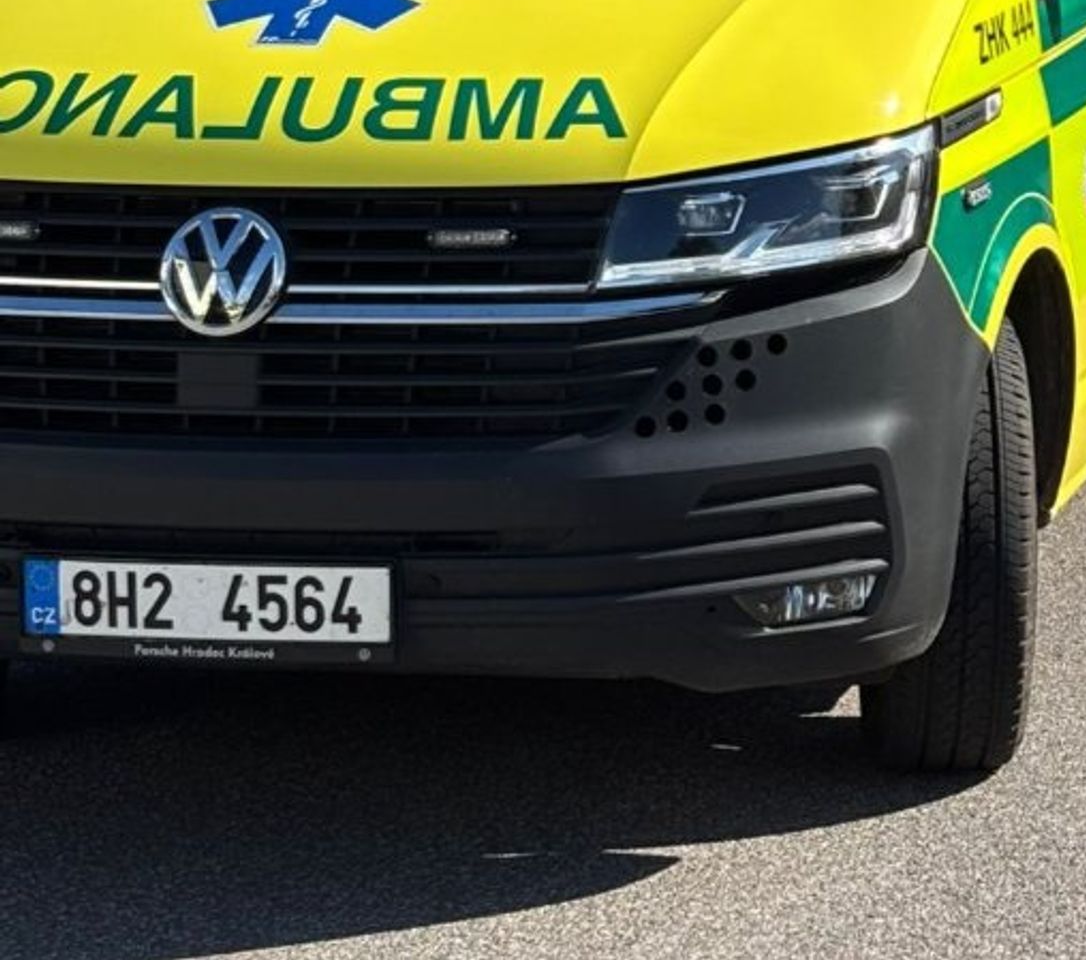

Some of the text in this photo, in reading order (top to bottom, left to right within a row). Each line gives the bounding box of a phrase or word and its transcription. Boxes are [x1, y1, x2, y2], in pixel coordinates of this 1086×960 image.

[974, 10, 1011, 66] ZHK
[31, 606, 57, 626] CZ
[72, 570, 363, 634] 8H2 4564
[133, 643, 179, 657] Porsche
[181, 644, 226, 659] Hradec
